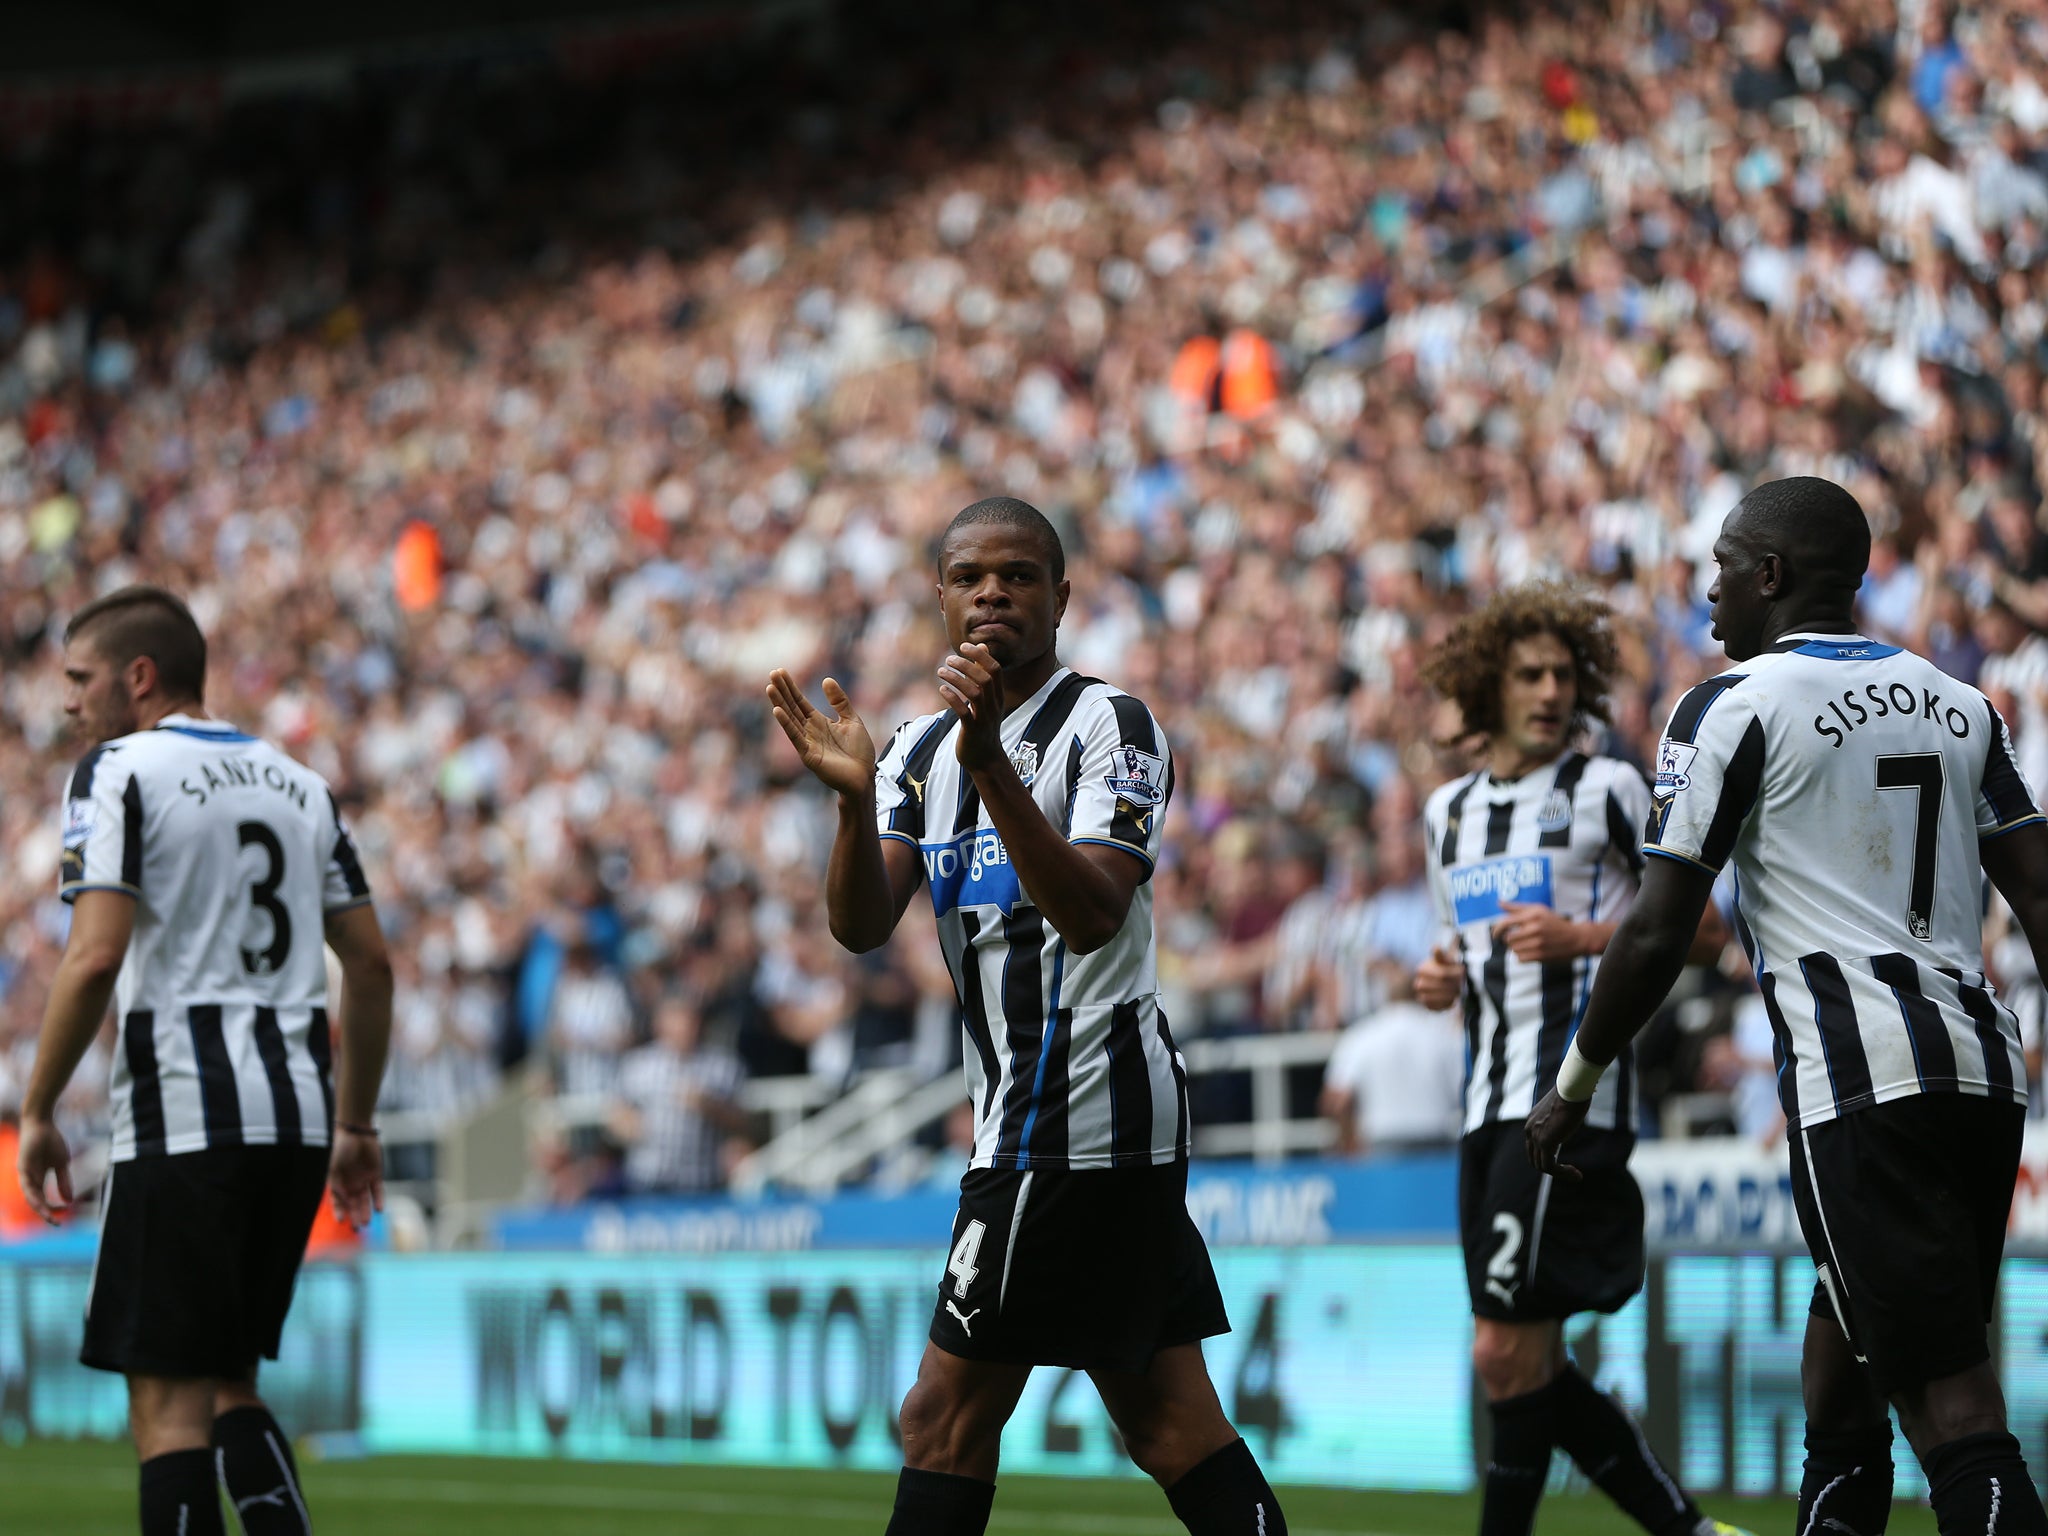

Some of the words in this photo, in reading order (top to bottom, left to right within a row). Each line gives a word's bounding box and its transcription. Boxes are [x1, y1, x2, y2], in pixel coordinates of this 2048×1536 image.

[1814, 682, 1970, 749] SISSOKO
[181, 757, 307, 808] SANTON
[1116, 781, 1150, 793] BARCLAYS
[1874, 750, 1946, 942] 7
[237, 819, 292, 976] 3
[948, 1218, 987, 1299] 4
[1487, 1211, 1523, 1279] 2
